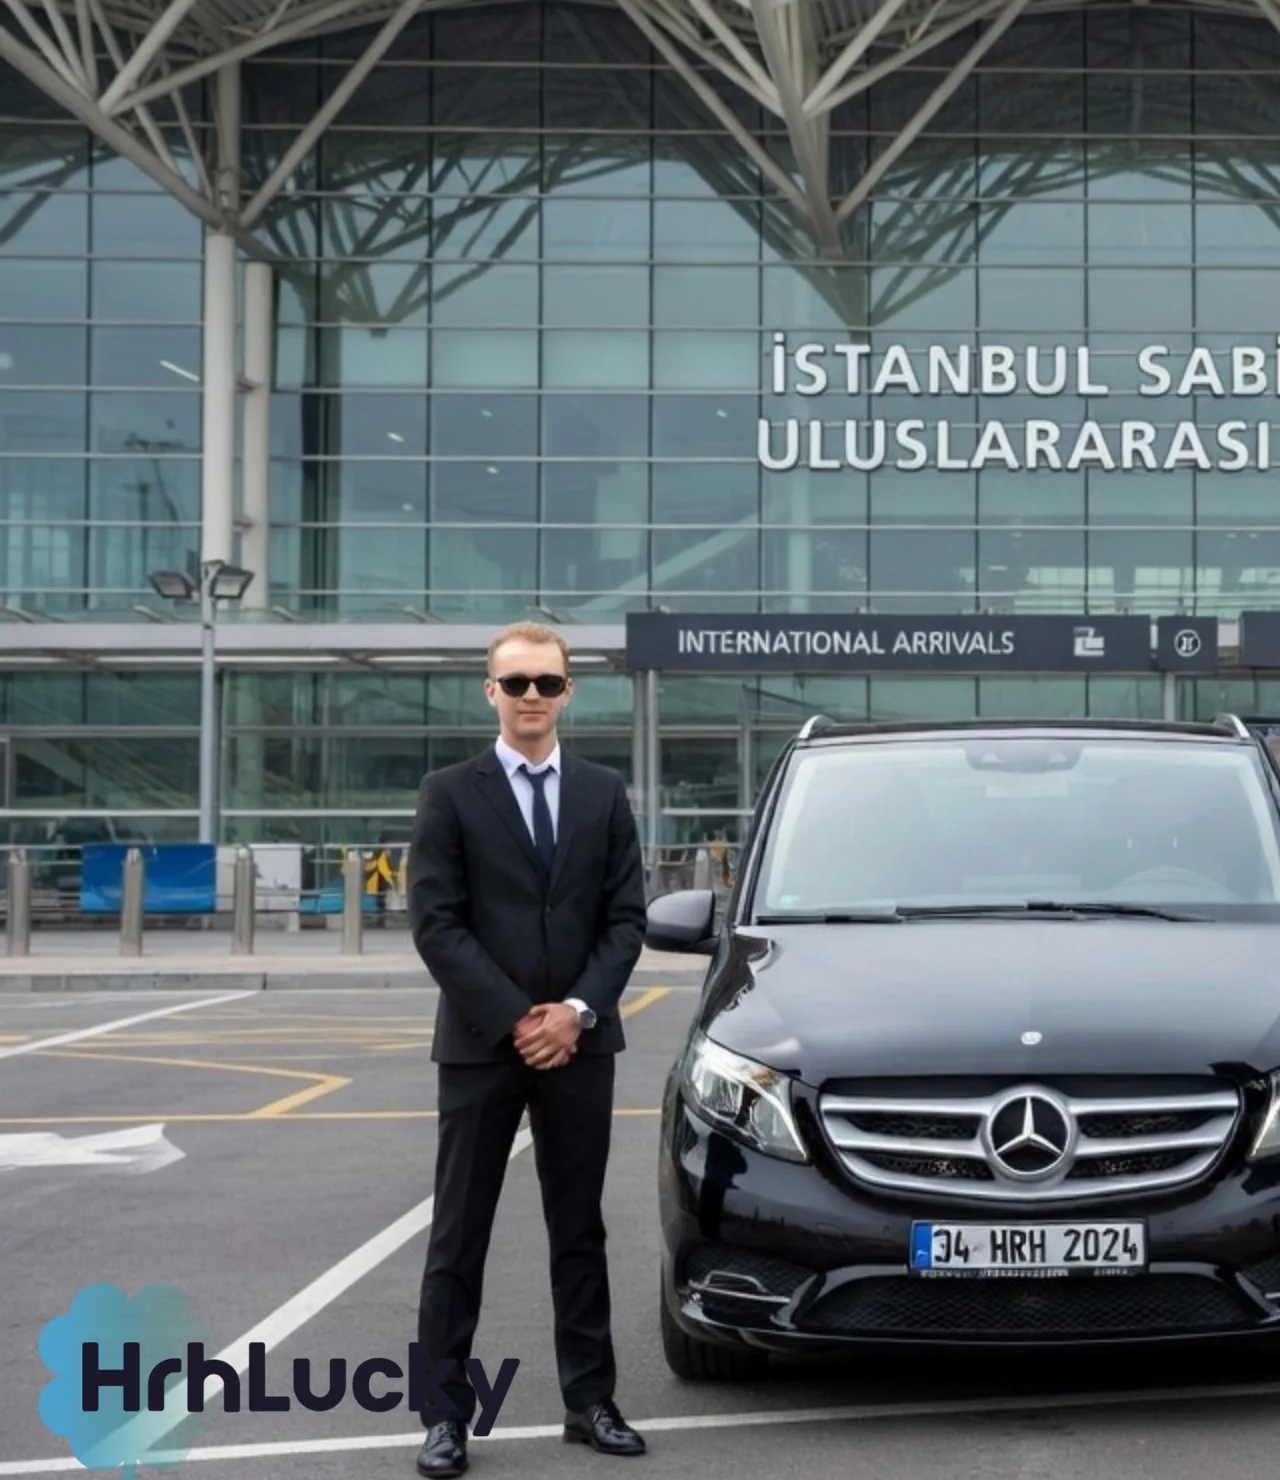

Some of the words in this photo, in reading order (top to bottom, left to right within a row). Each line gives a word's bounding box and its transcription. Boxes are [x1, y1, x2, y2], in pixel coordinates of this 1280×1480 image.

[771, 332, 1110, 398] İSTANBUL
[757, 418, 1271, 472] ULUSLARARASI
[677, 629, 886, 656] INTERNATIONAL
[892, 629, 1016, 656] ARRIVALS
[989, 1229, 1047, 1263] HRH
[1062, 1227, 1139, 1262] 2024
